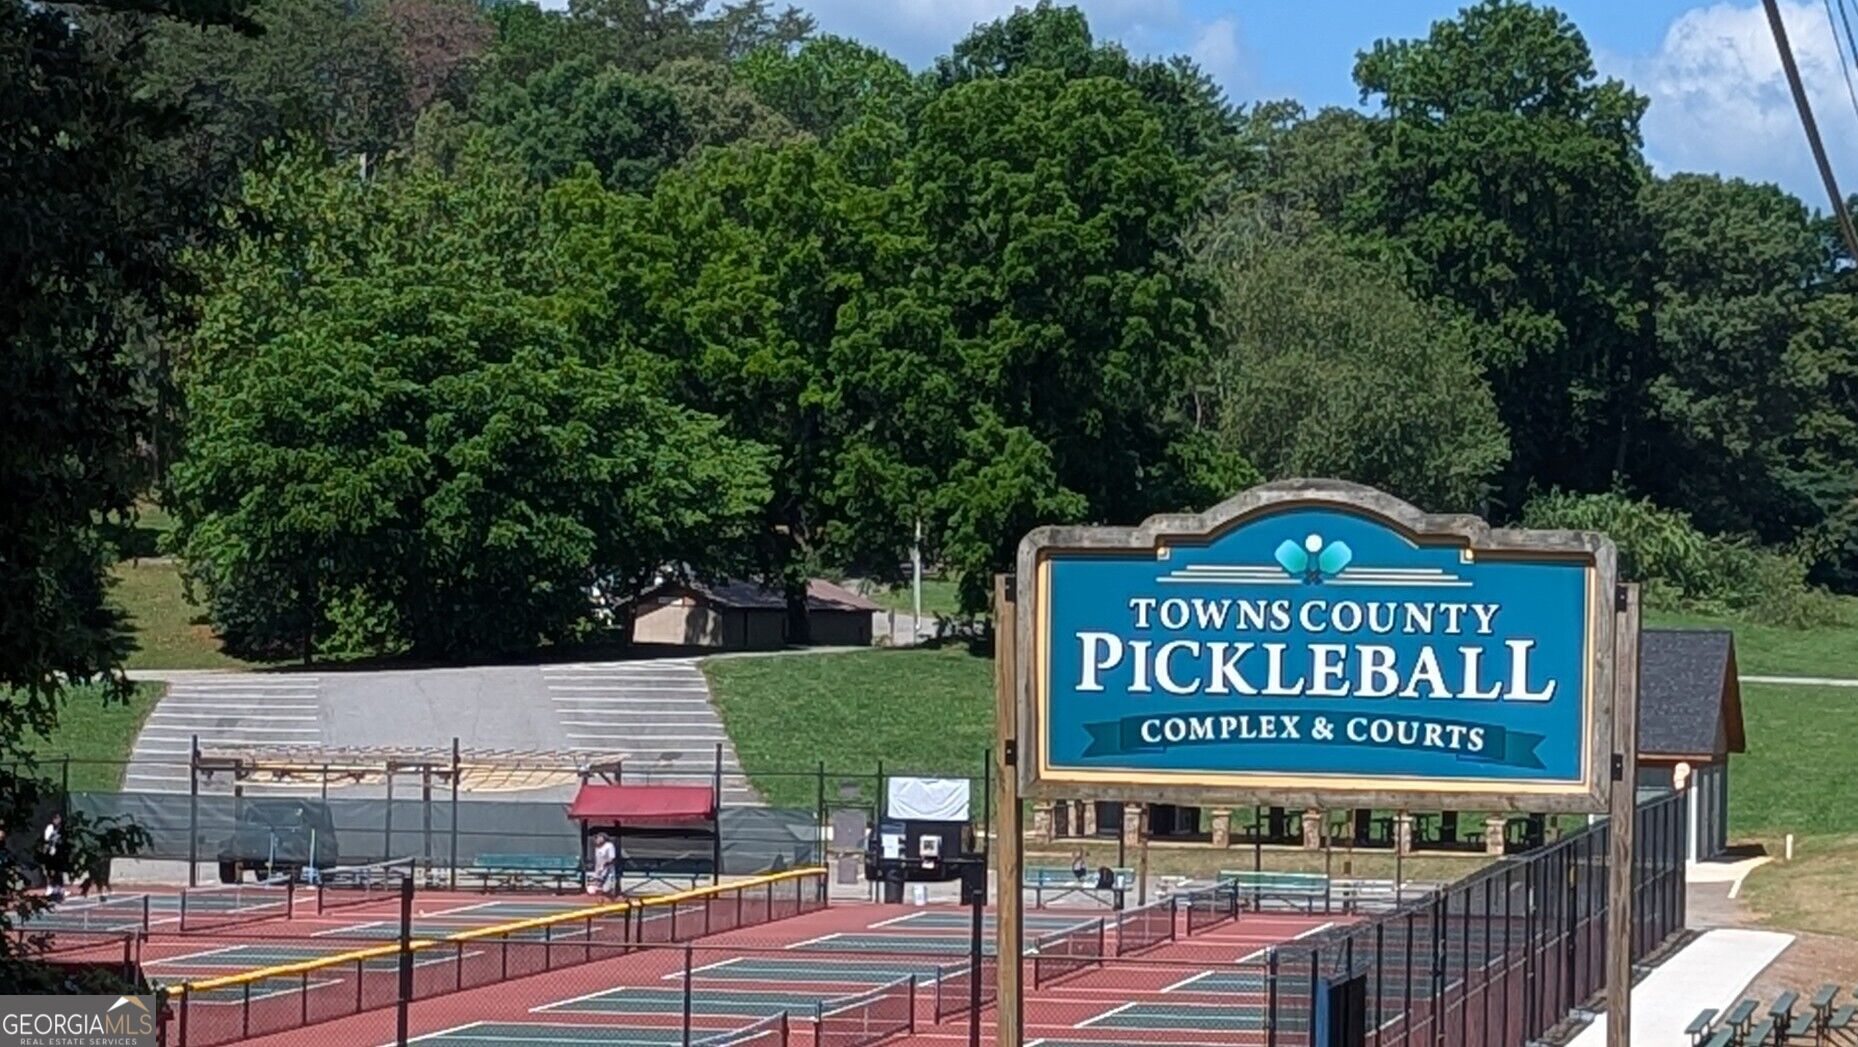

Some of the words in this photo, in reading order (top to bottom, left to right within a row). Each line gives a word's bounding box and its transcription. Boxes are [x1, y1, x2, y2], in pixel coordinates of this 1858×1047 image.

[1129, 597, 1291, 633] TOWNS
[1299, 599, 1500, 636] COUNTY
[1074, 631, 1557, 703] PICKLEBALL
[1140, 715, 1300, 744] COMPLEX
[1311, 716, 1335, 740] &
[1346, 717, 1485, 752] COURTS
